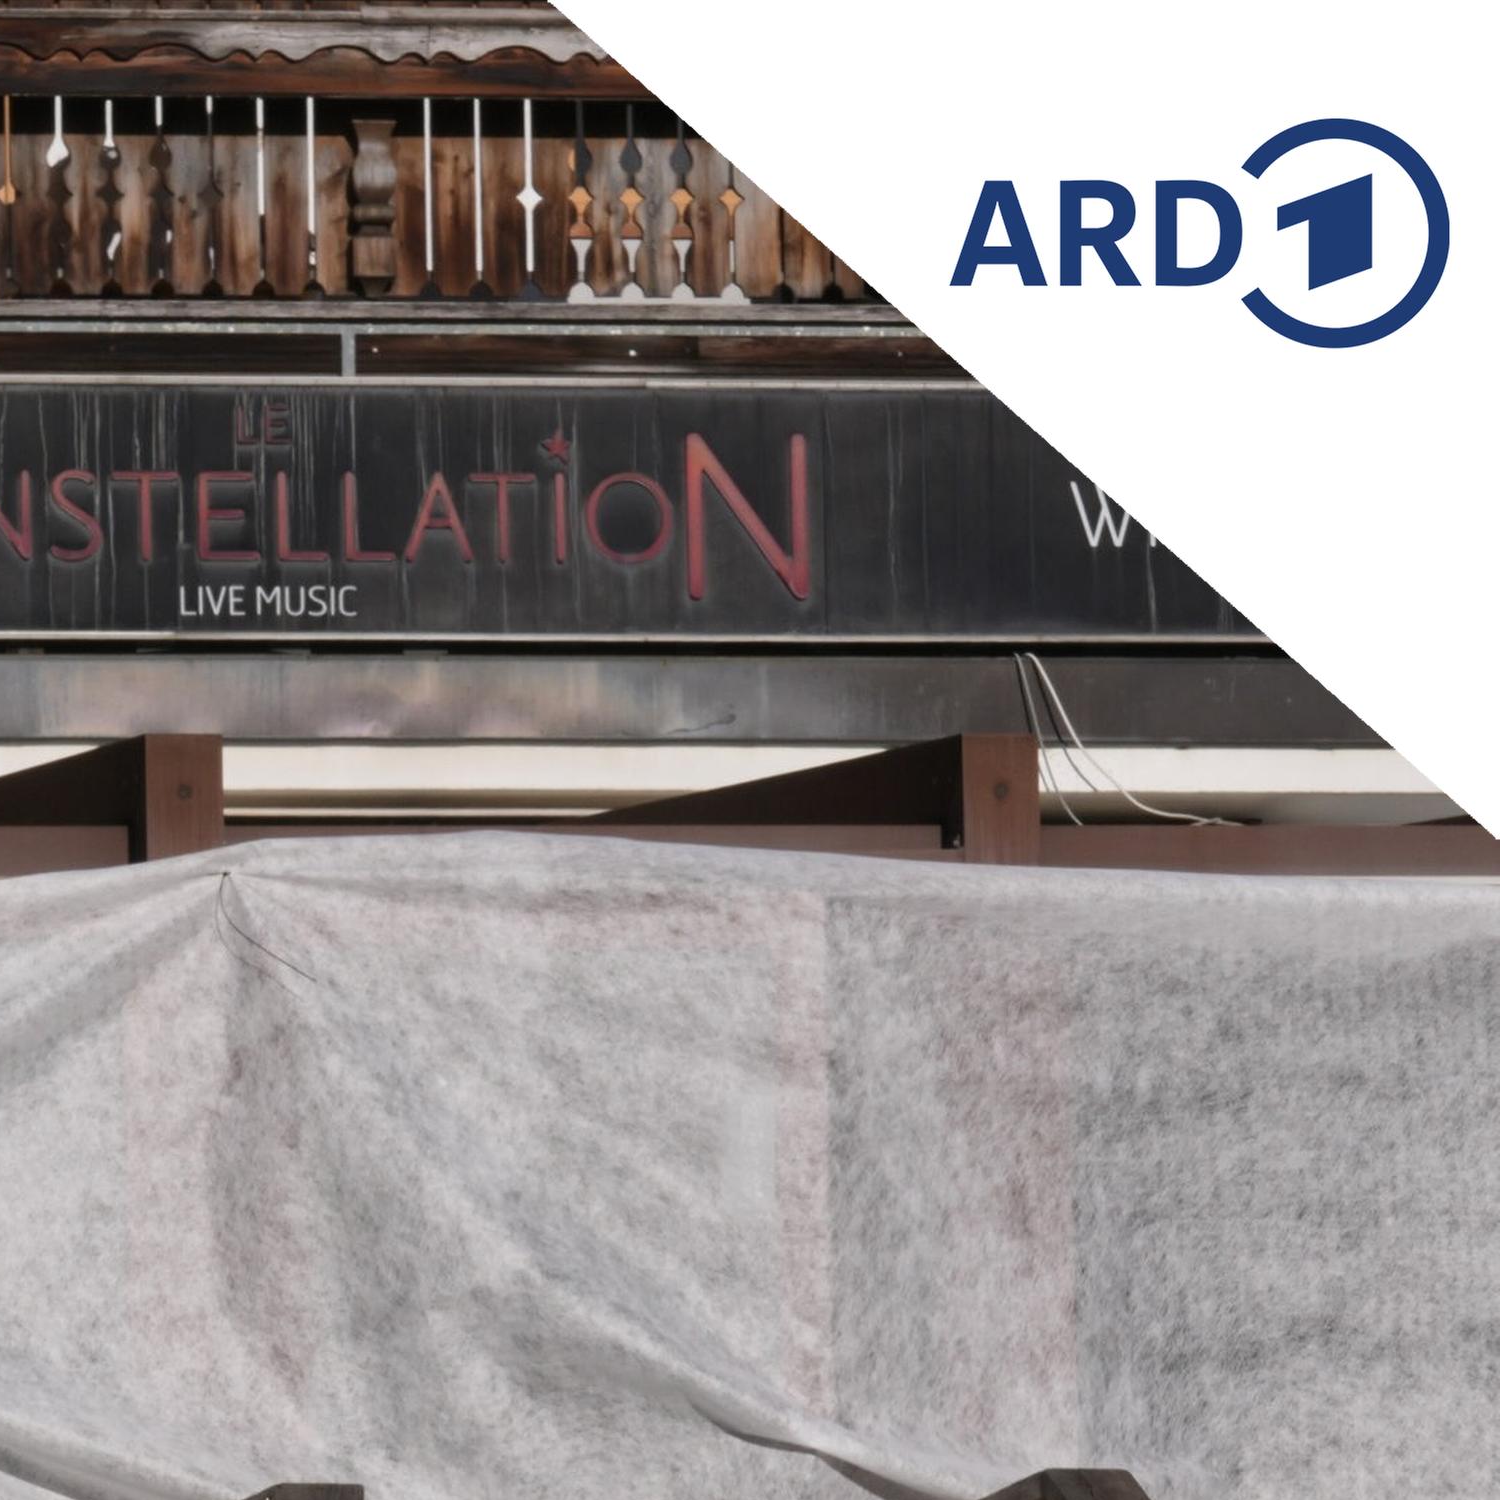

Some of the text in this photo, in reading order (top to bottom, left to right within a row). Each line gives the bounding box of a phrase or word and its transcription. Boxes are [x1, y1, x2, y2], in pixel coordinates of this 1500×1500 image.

[235, 403, 292, 445] LE
[1070, 481, 1156, 547] W
[180, 585, 358, 617] LIVE MUSIC
